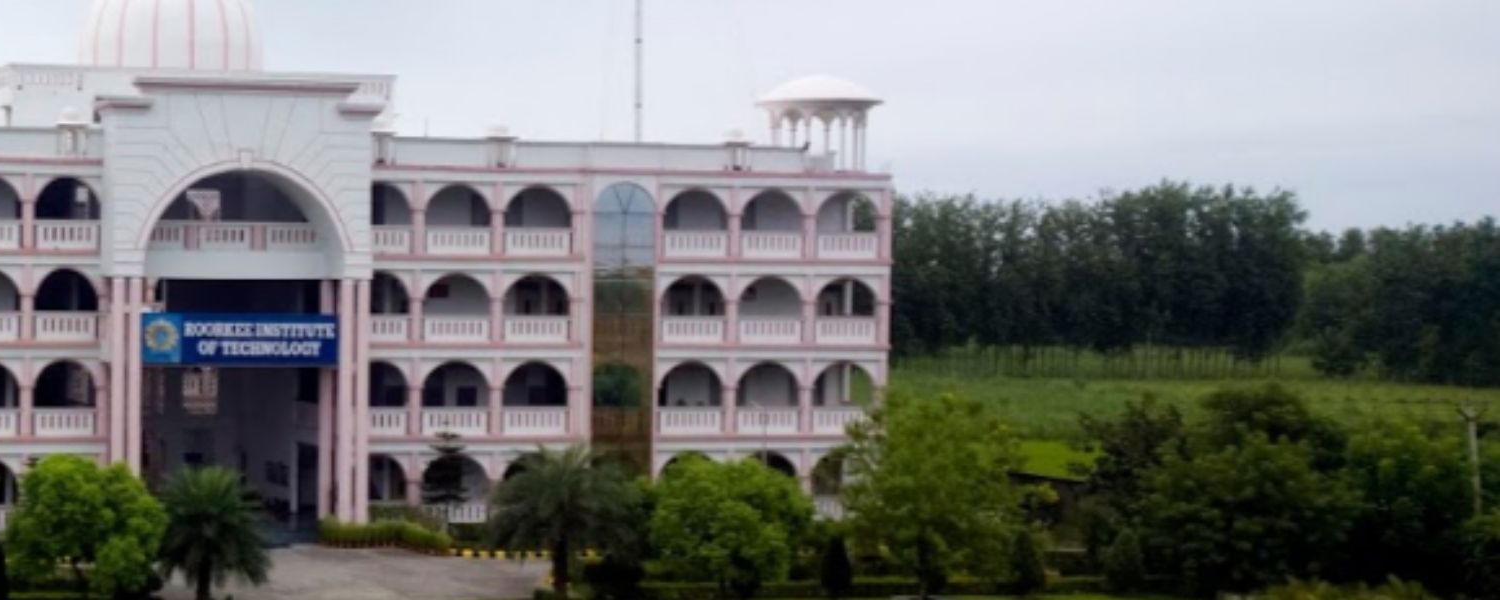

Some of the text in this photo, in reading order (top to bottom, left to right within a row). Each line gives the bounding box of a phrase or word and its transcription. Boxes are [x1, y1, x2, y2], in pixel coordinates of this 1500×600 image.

[184, 322, 335, 338] ROORKEE INSTITUTE
[197, 341, 322, 356] OF TECHNOLOGY
